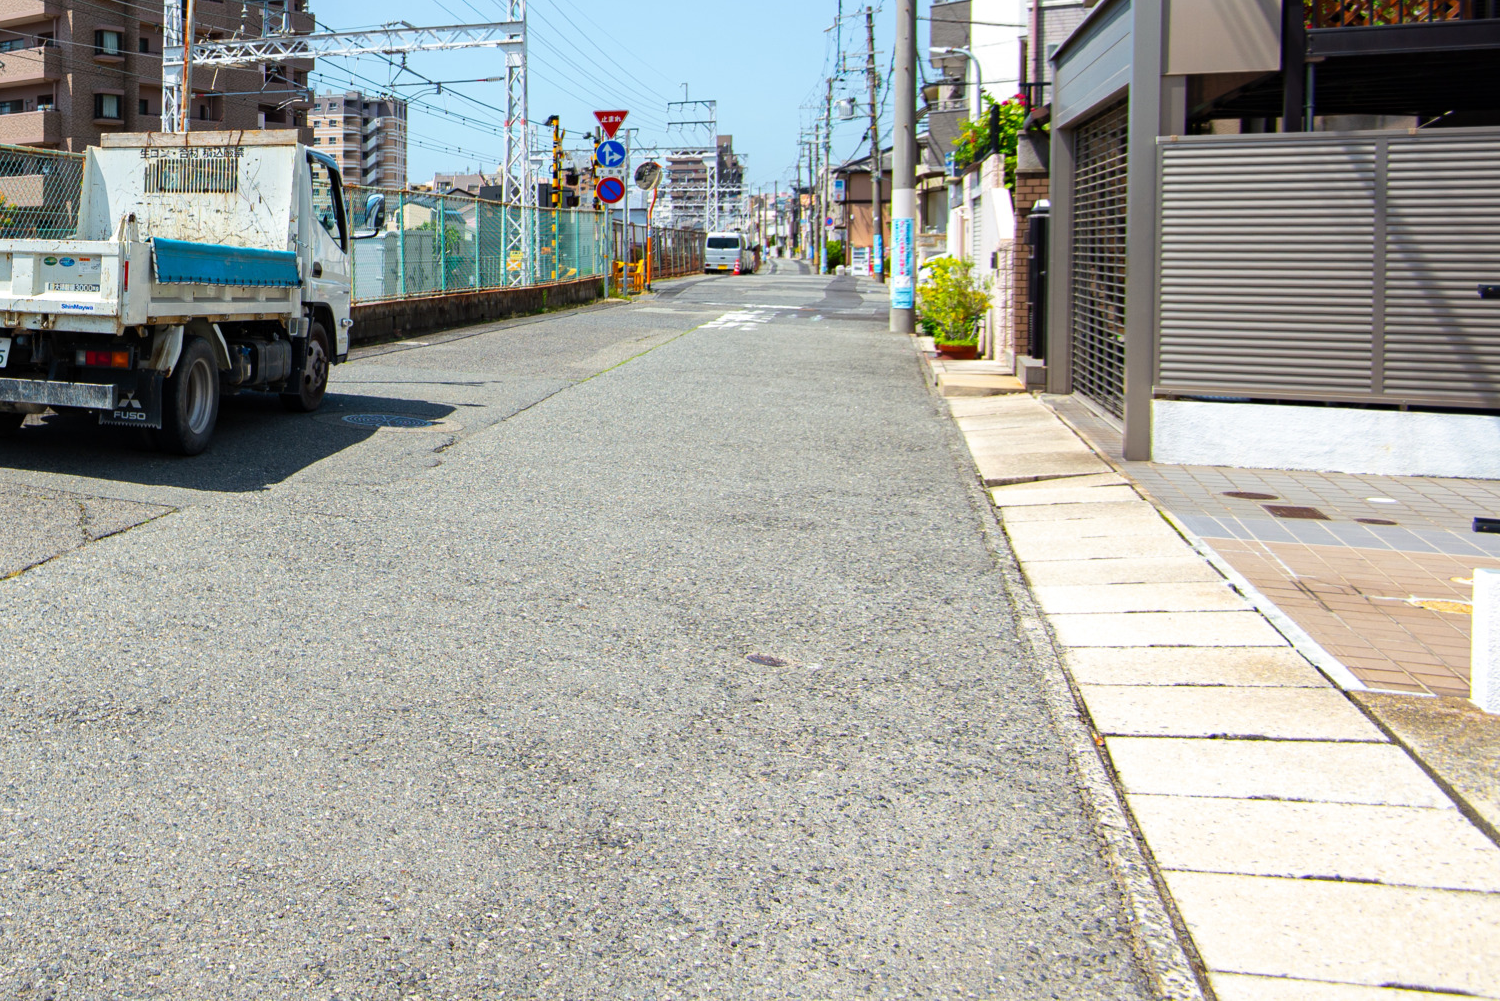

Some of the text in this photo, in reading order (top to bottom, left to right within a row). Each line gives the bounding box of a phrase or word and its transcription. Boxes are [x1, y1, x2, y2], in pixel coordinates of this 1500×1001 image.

[601, 115, 622, 123] 止まれ
[61, 303, 93, 311] ShinMaywa
[113, 410, 146, 421] FUSO
